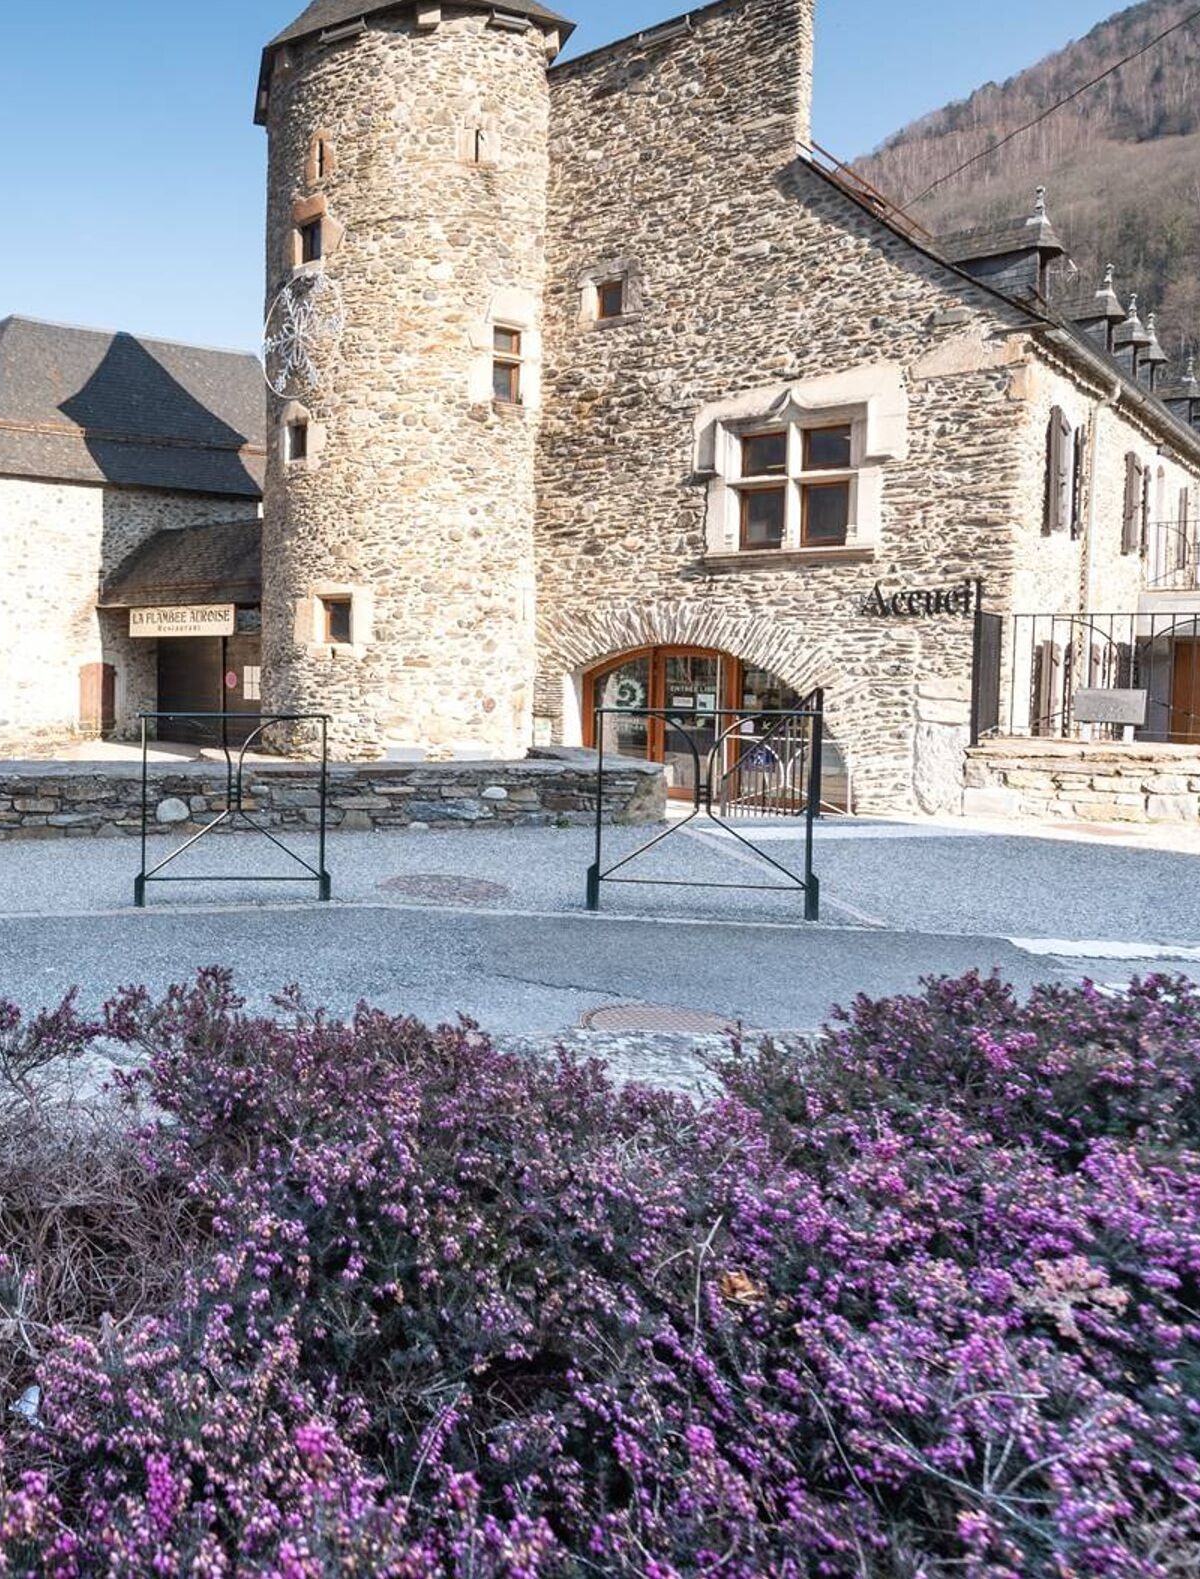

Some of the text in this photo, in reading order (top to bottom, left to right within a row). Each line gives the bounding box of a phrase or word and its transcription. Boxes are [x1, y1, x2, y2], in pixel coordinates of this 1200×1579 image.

[132, 612, 144, 624] LA
[190, 609, 230, 622] AUROISE
[158, 624, 201, 633] Restaurant
